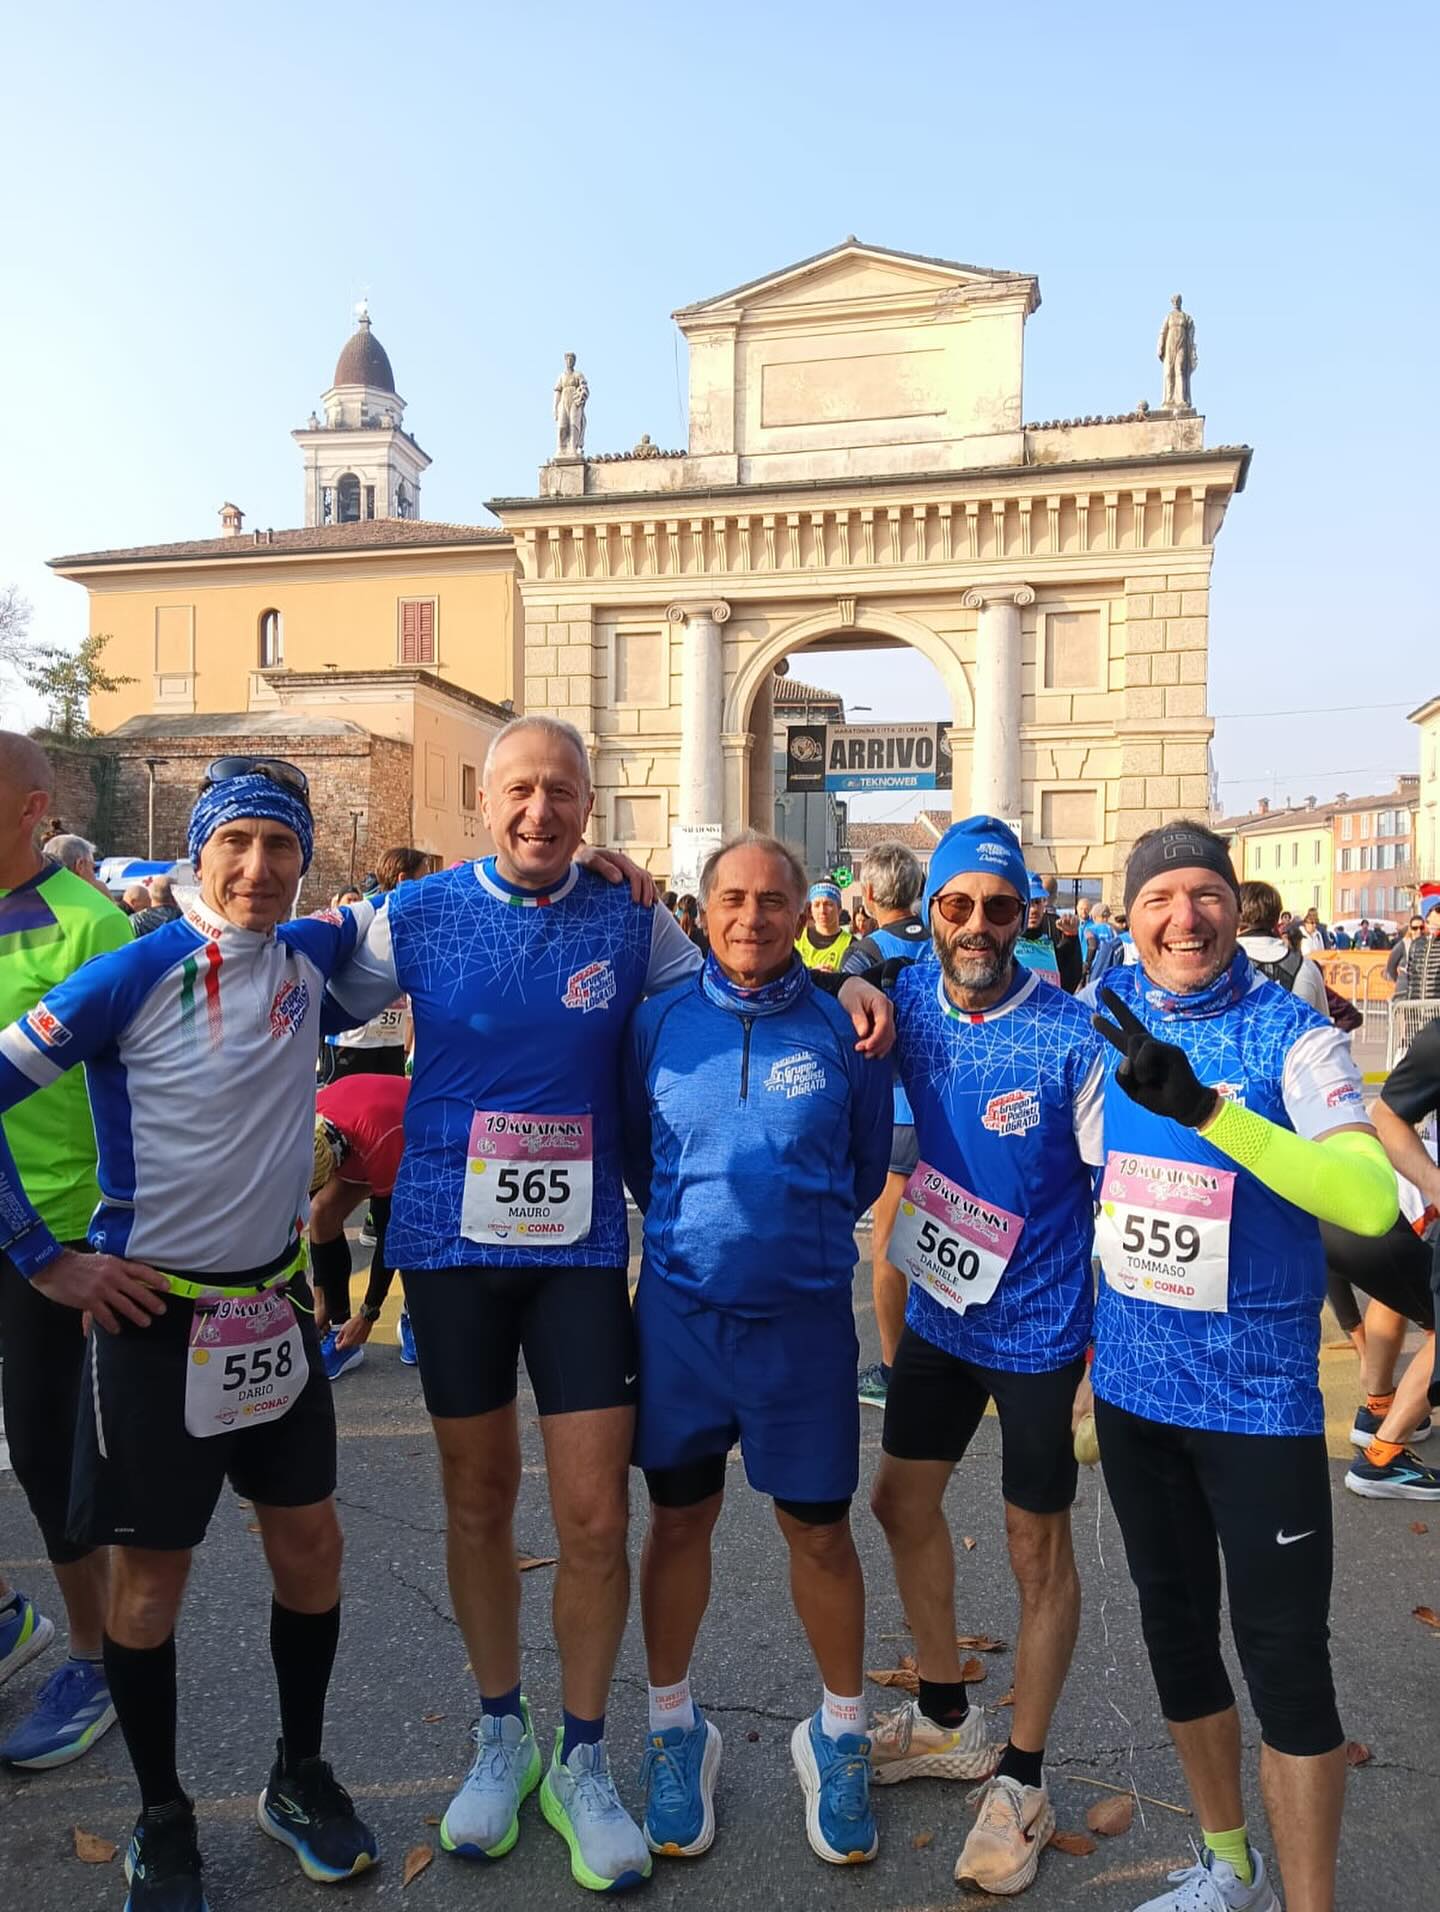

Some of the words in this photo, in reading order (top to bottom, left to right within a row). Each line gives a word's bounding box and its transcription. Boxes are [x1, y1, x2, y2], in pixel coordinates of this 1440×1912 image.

[829, 736, 934, 770] ARRIVO
[860, 776, 918, 787] TEKNOWEB
[785, 1061, 817, 1078] Gruppo
[786, 1078, 826, 1099] LOGRATO
[1000, 1098, 1030, 1114] Gruppo
[1001, 1115, 1038, 1133] LOGRATO
[495, 1168, 571, 1204] 565
[508, 1207, 551, 1218] MAURO
[527, 1223, 565, 1233] CONAD
[1122, 1214, 1201, 1263] 559
[916, 1220, 980, 1282] 560
[920, 1254, 960, 1286] DANIELE
[1127, 1256, 1186, 1278] TOMMASO
[934, 1279, 964, 1305] CONAD
[1154, 1280, 1196, 1297] CONAD
[222, 1340, 293, 1391] 558
[238, 1384, 273, 1401] DARIO
[253, 1395, 290, 1413] CONAD
